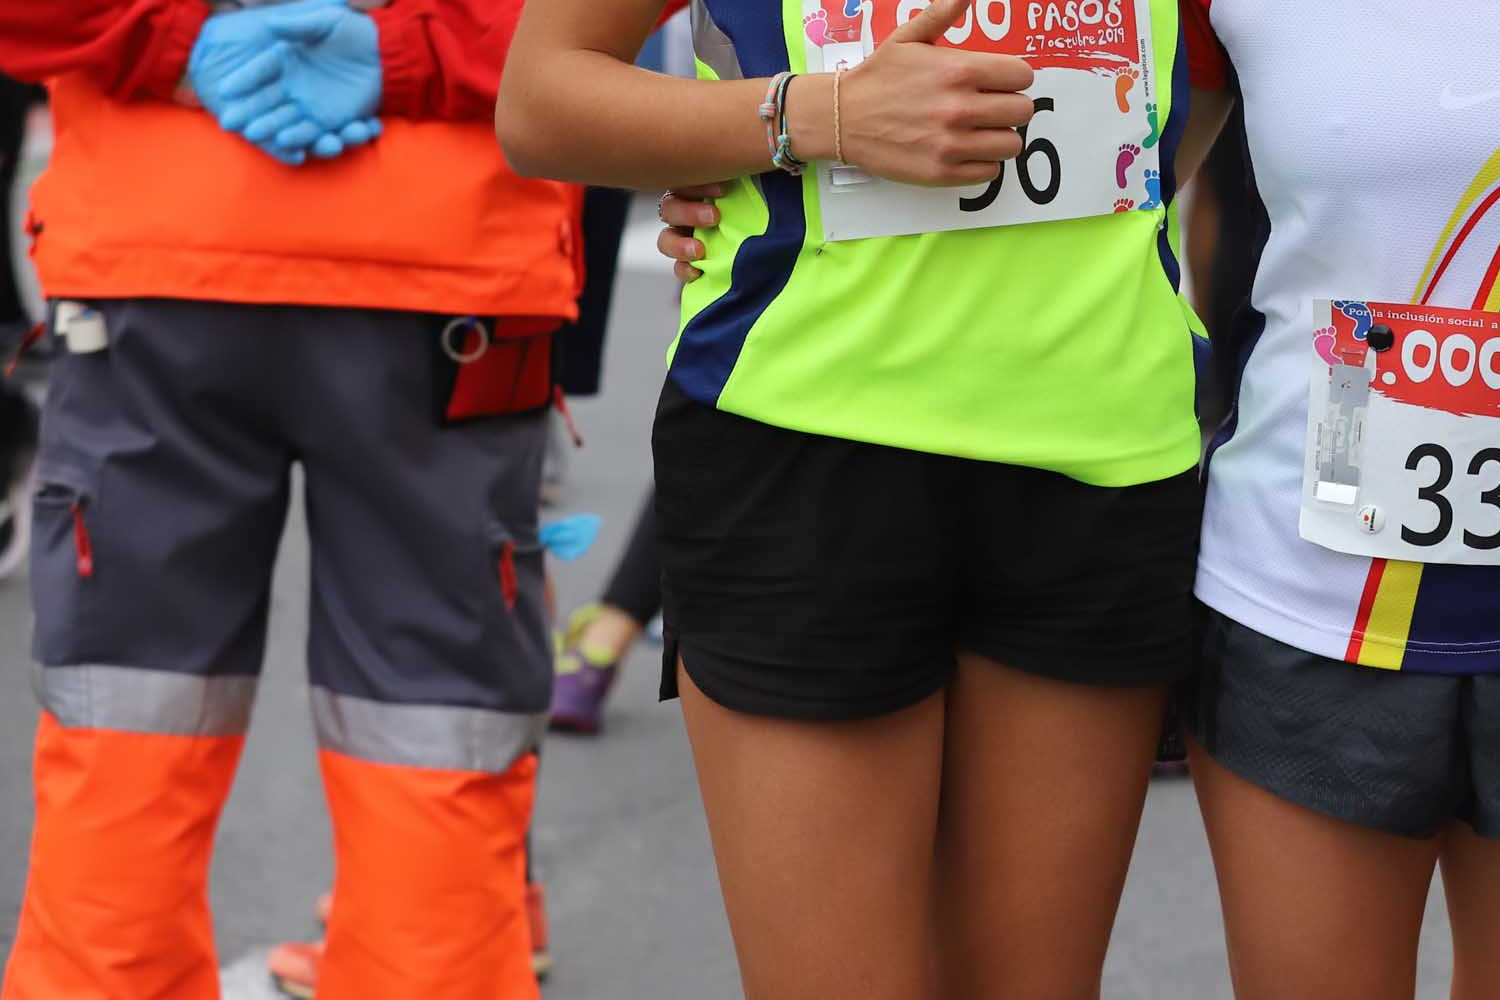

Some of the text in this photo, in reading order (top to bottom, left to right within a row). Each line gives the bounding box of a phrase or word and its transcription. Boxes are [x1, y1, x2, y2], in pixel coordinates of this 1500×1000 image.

[1026, 27, 1125, 52] 27 octubre 2019
[1348, 307, 1370, 317] Por
[1372, 308, 1384, 318] la
[1387, 310, 1444, 324] inclusión
[1447, 317, 1484, 328] social
[1491, 321, 1498, 329] a
